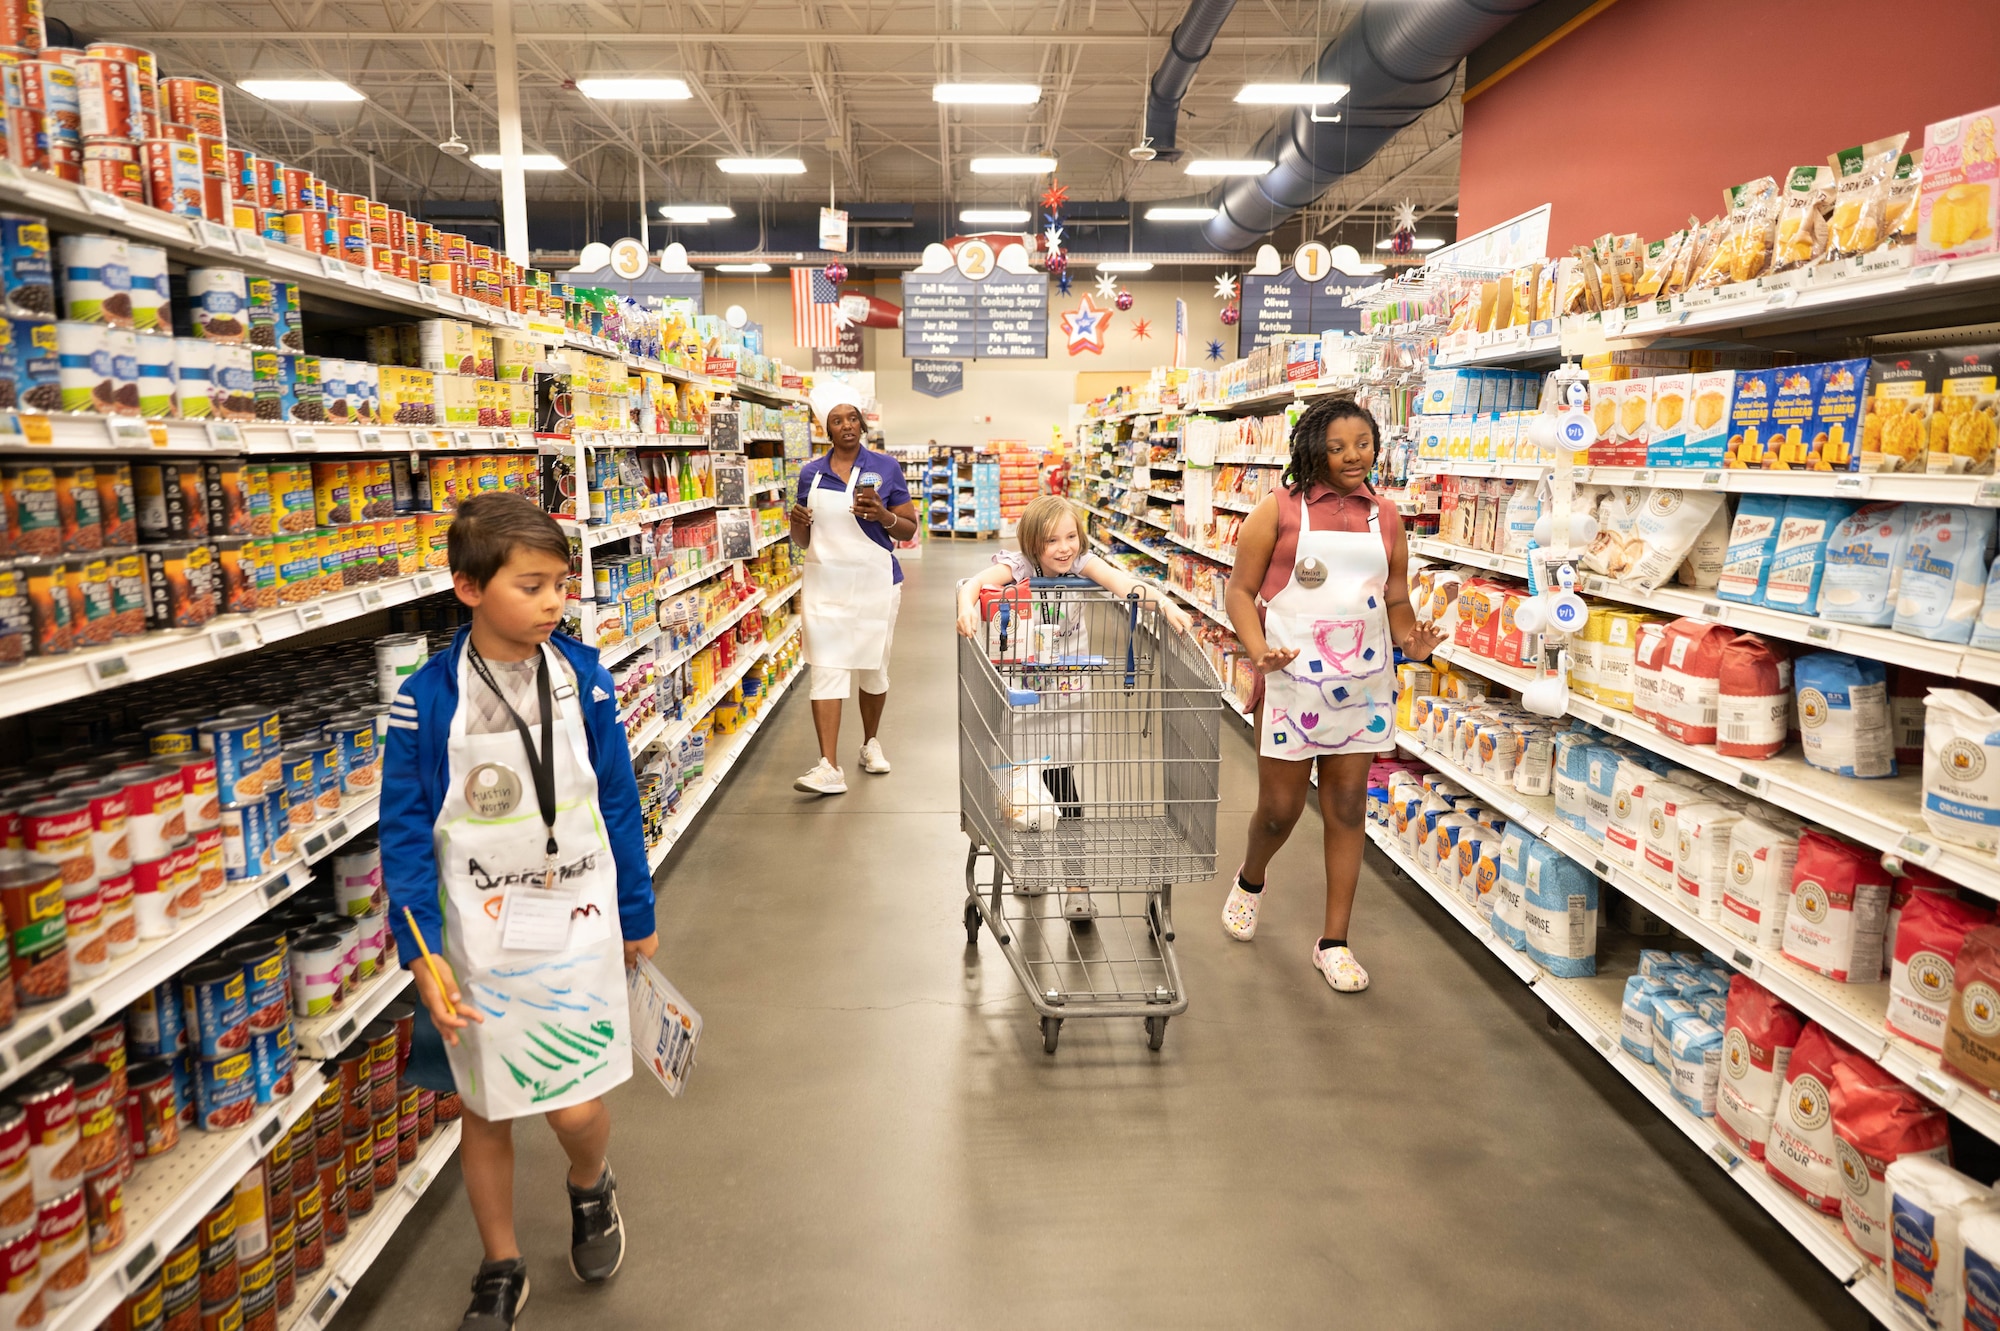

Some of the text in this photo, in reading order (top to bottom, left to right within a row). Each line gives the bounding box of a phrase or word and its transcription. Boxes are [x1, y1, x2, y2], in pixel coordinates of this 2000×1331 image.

[1924, 145, 1962, 170] Dolly
[620, 246, 639, 273] 3
[966, 247, 986, 273] 2
[1305, 249, 1318, 275] 1
[1615, 258, 1631, 267] BREAD
[922, 284, 958, 293] Foil Pans
[983, 284, 1039, 295] Vegetable Oil
[1263, 285, 1291, 295] Pickles
[1325, 285, 1343, 295] Club
[914, 296, 966, 306] Canned Fruit
[981, 297, 1041, 308] Cooking Spray
[1263, 297, 1289, 307] Olives
[911, 308, 970, 318] Marshmallows
[988, 309, 1033, 320] Shortening
[1258, 309, 1292, 320] Mustard
[923, 320, 958, 330] Jar Fruit
[992, 321, 1029, 331] Olive Oil
[1259, 321, 1292, 333] Ketchup
[922, 333, 959, 344] Puddings
[988, 333, 1032, 344] Pie Fillings
[931, 344, 950, 354] Jello
[986, 345, 1036, 355] Cake Mixes
[818, 353, 857, 364] To The
[707, 361, 735, 371] AWESOME
[914, 363, 961, 373] Existence.
[1289, 365, 1317, 378] CHECK
[926, 373, 949, 383] You.
[1567, 427, 1583, 437] 1/4
[1738, 559, 1759, 576] FLOUR
[1917, 557, 1951, 578] Flour
[1787, 566, 1811, 583] FLOUR
[1558, 608, 1574, 618] 1/4
[151, 738, 192, 750] BUSH'S
[1805, 741, 1822, 750] FLOUR
[472, 788, 511, 801] Austin
[1938, 784, 1989, 802] BREAD FLOUR
[1938, 801, 1985, 821] ORGANIC
[1608, 830, 1628, 846] ORGANIC
[1645, 851, 1665, 868] ORGANIC
[1727, 898, 1749, 917] ORGANIC
[1525, 910, 1550, 934] PURPOSE
[1789, 924, 1831, 945] ALL-PURPOSE
[1798, 935, 1819, 947] FLOUR
[1912, 1009, 1941, 1028] FLOUR
[1773, 1121, 1833, 1166] ALL-PURPOSE
[1779, 1139, 1810, 1168] FLOUR
[1894, 1218, 1930, 1255] Pillsbury
